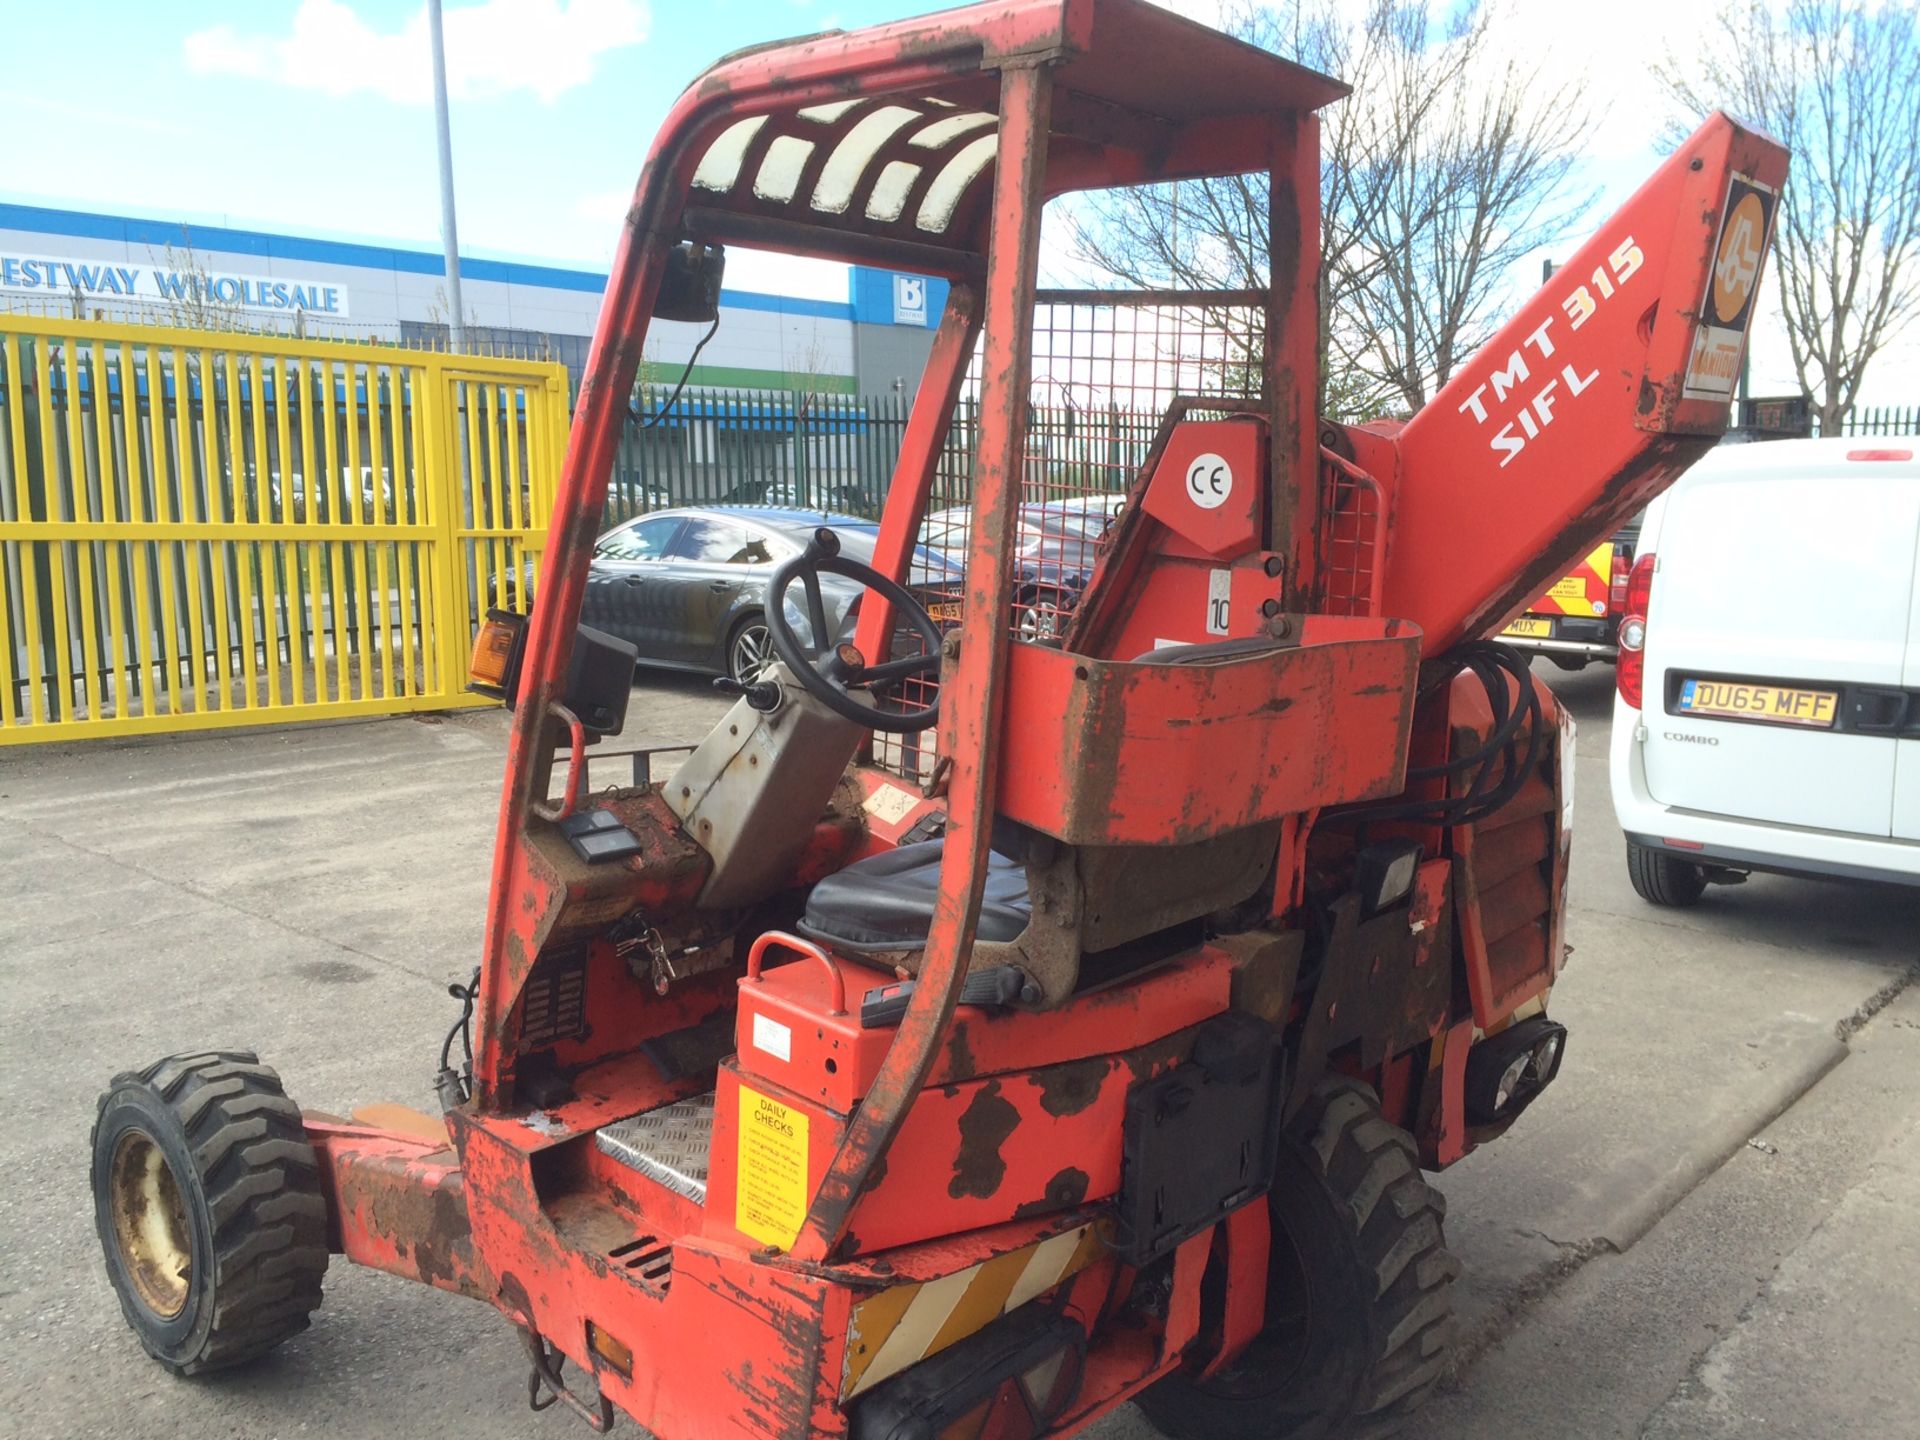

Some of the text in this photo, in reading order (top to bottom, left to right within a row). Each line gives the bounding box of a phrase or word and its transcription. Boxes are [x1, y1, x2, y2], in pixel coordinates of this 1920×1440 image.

[153, 271, 339, 313] WHOLESALE
[1458, 235, 1645, 425] TMT 315
[1489, 363, 1600, 468] SIFL
[1191, 466, 1223, 495] CE
[1211, 598, 1230, 630] 10
[1510, 620, 1536, 633] MUX
[1697, 683, 1833, 717] DU65 MFF
[1663, 731, 1720, 746] COMBO
[754, 1110, 794, 1137] CHECKS
[760, 1099, 787, 1119] DAILY
